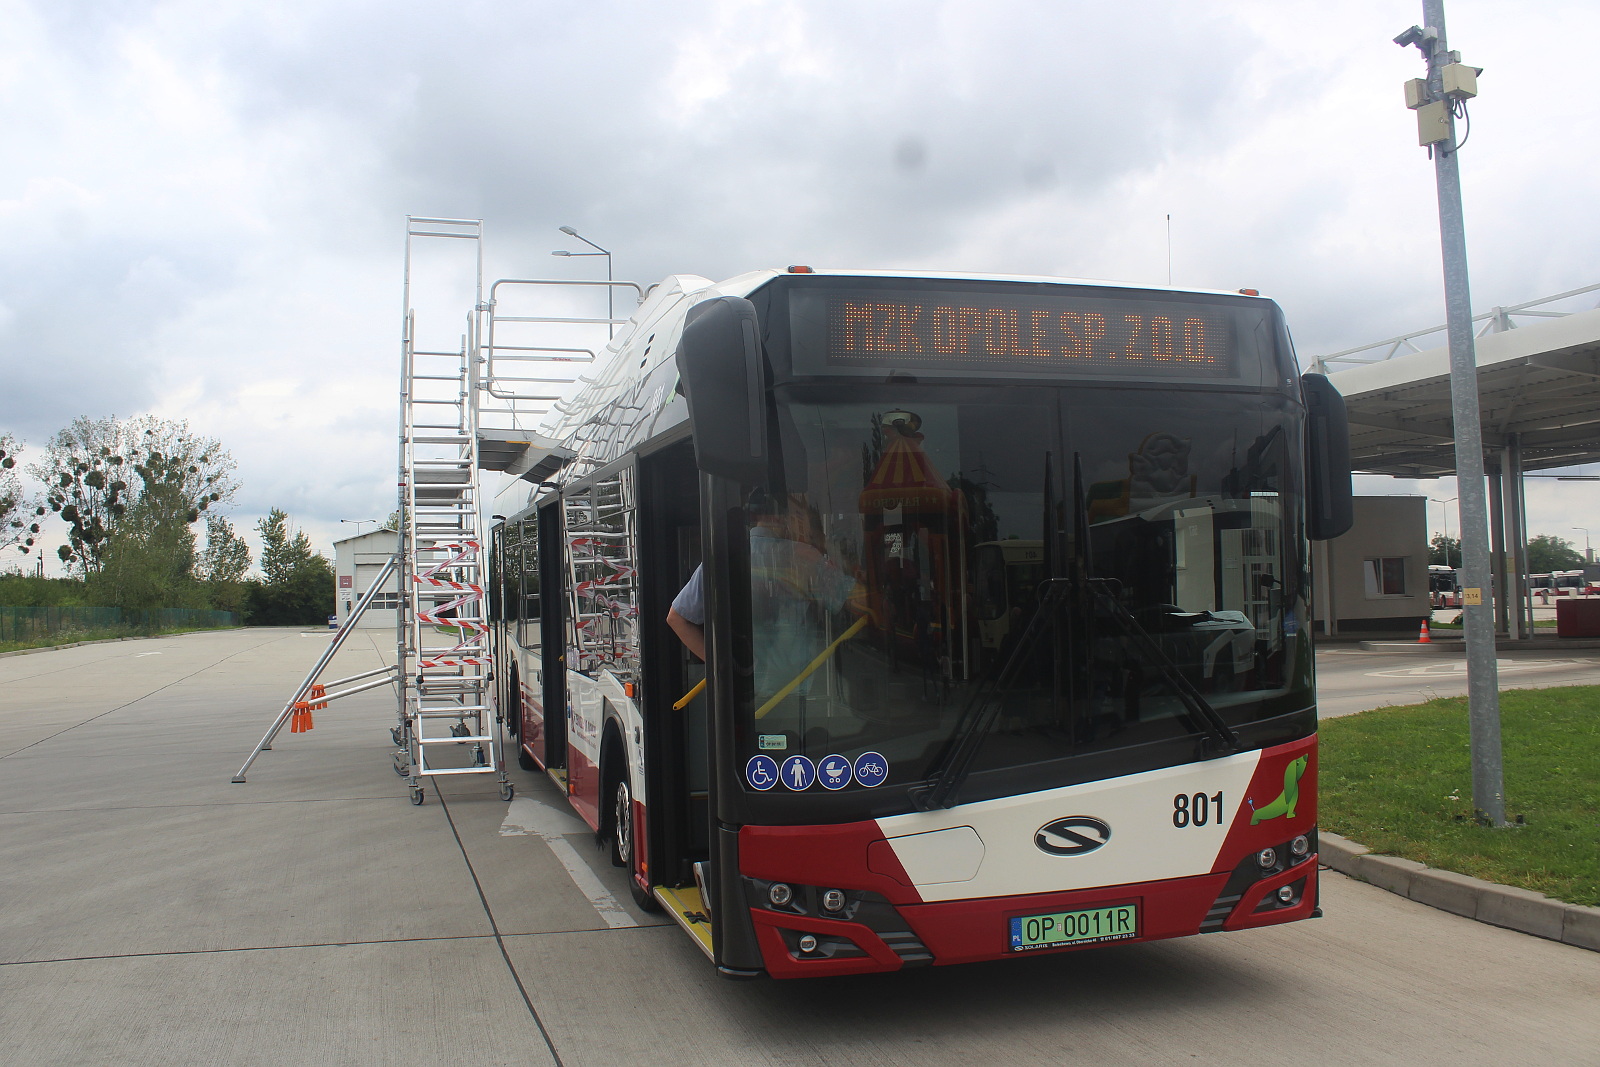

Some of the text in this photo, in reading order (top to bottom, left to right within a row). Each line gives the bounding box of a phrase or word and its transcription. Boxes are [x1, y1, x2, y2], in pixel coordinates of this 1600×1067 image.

[845, 303, 922, 353] MZK
[933, 306, 1050, 357] OPOLE
[1173, 791, 1222, 828] 801
[1027, 917, 1055, 942] OP
[1064, 908, 1130, 937] 0011R
